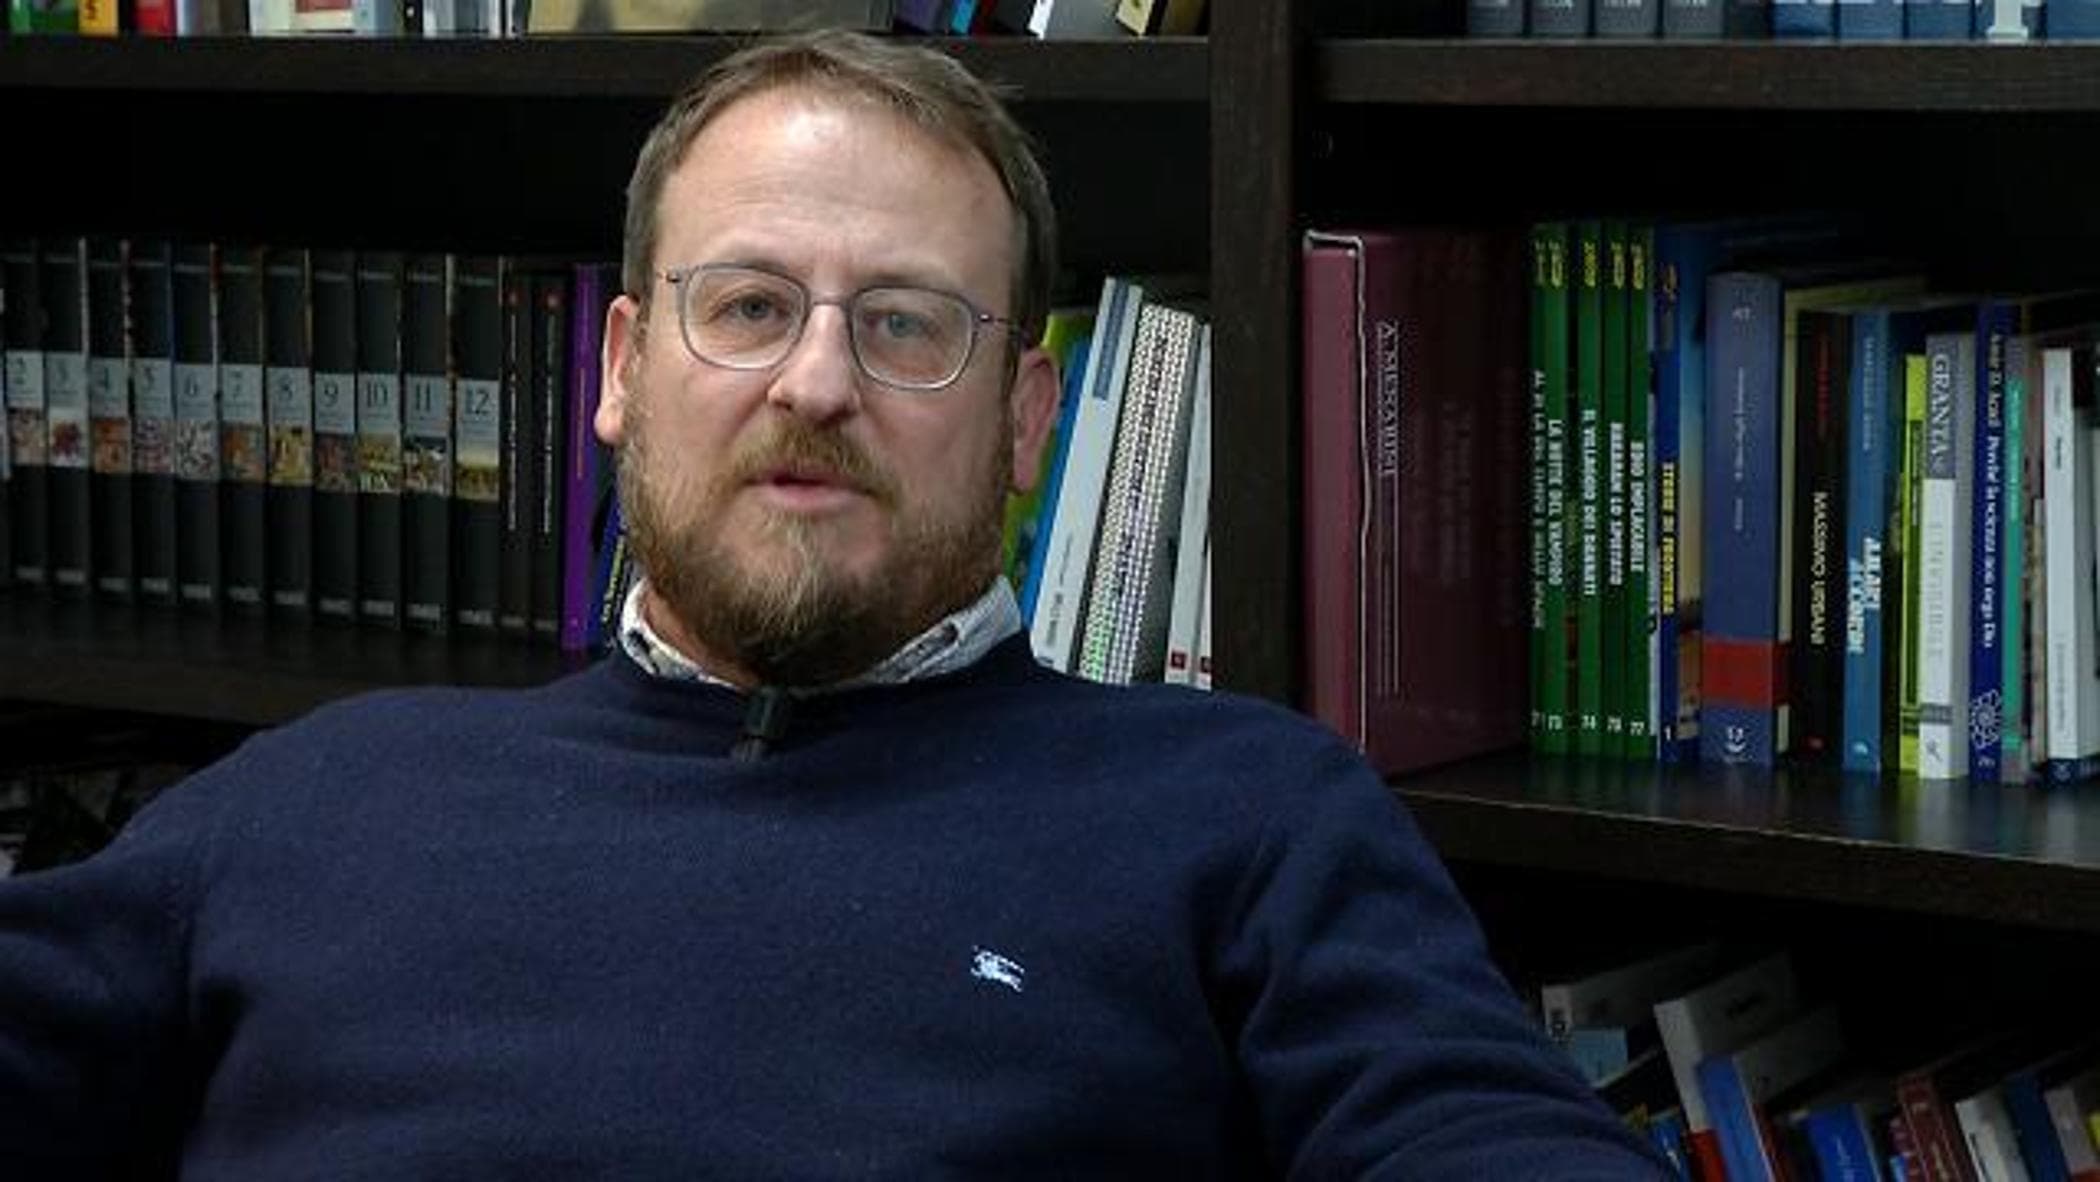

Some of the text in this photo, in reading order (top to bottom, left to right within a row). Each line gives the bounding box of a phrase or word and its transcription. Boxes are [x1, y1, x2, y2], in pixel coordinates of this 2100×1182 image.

[14, 356, 28, 386] 2
[184, 370, 199, 397] 6
[230, 369, 244, 397] 7
[278, 371, 294, 400] 8
[323, 379, 339, 407] 9
[365, 379, 389, 408] 10
[414, 380, 432, 412] 11
[464, 387, 490, 416] 12
[1930, 352, 1953, 455] GRANTA
[1809, 490, 1829, 646] MASSIMO URBANI
